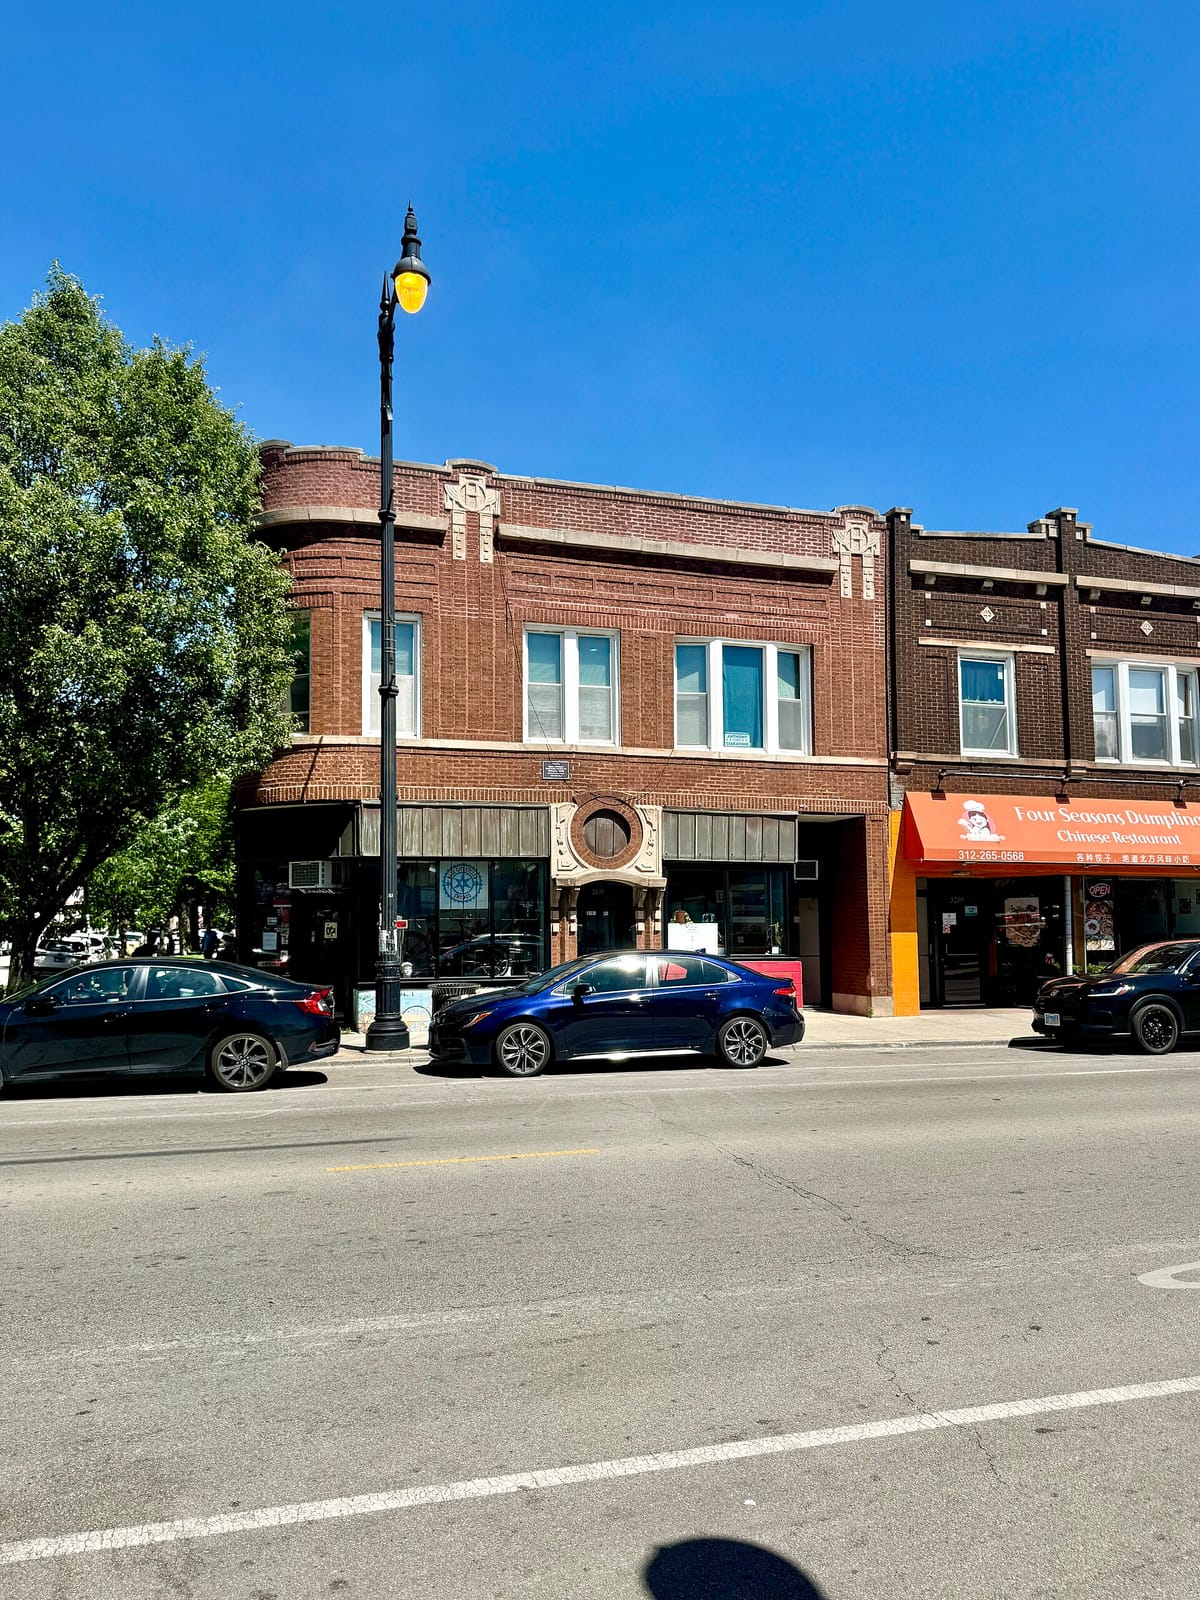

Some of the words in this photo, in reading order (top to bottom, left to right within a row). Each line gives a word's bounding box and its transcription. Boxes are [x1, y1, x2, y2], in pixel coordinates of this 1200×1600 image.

[1013, 806, 1056, 822] Four
[1058, 807, 1126, 826] Seasons
[1056, 829, 1112, 844] Chinese
[1111, 831, 1183, 846] Restaurant
[958, 850, 1025, 861] 312-265-0568
[1089, 885, 1111, 896] OPEN
